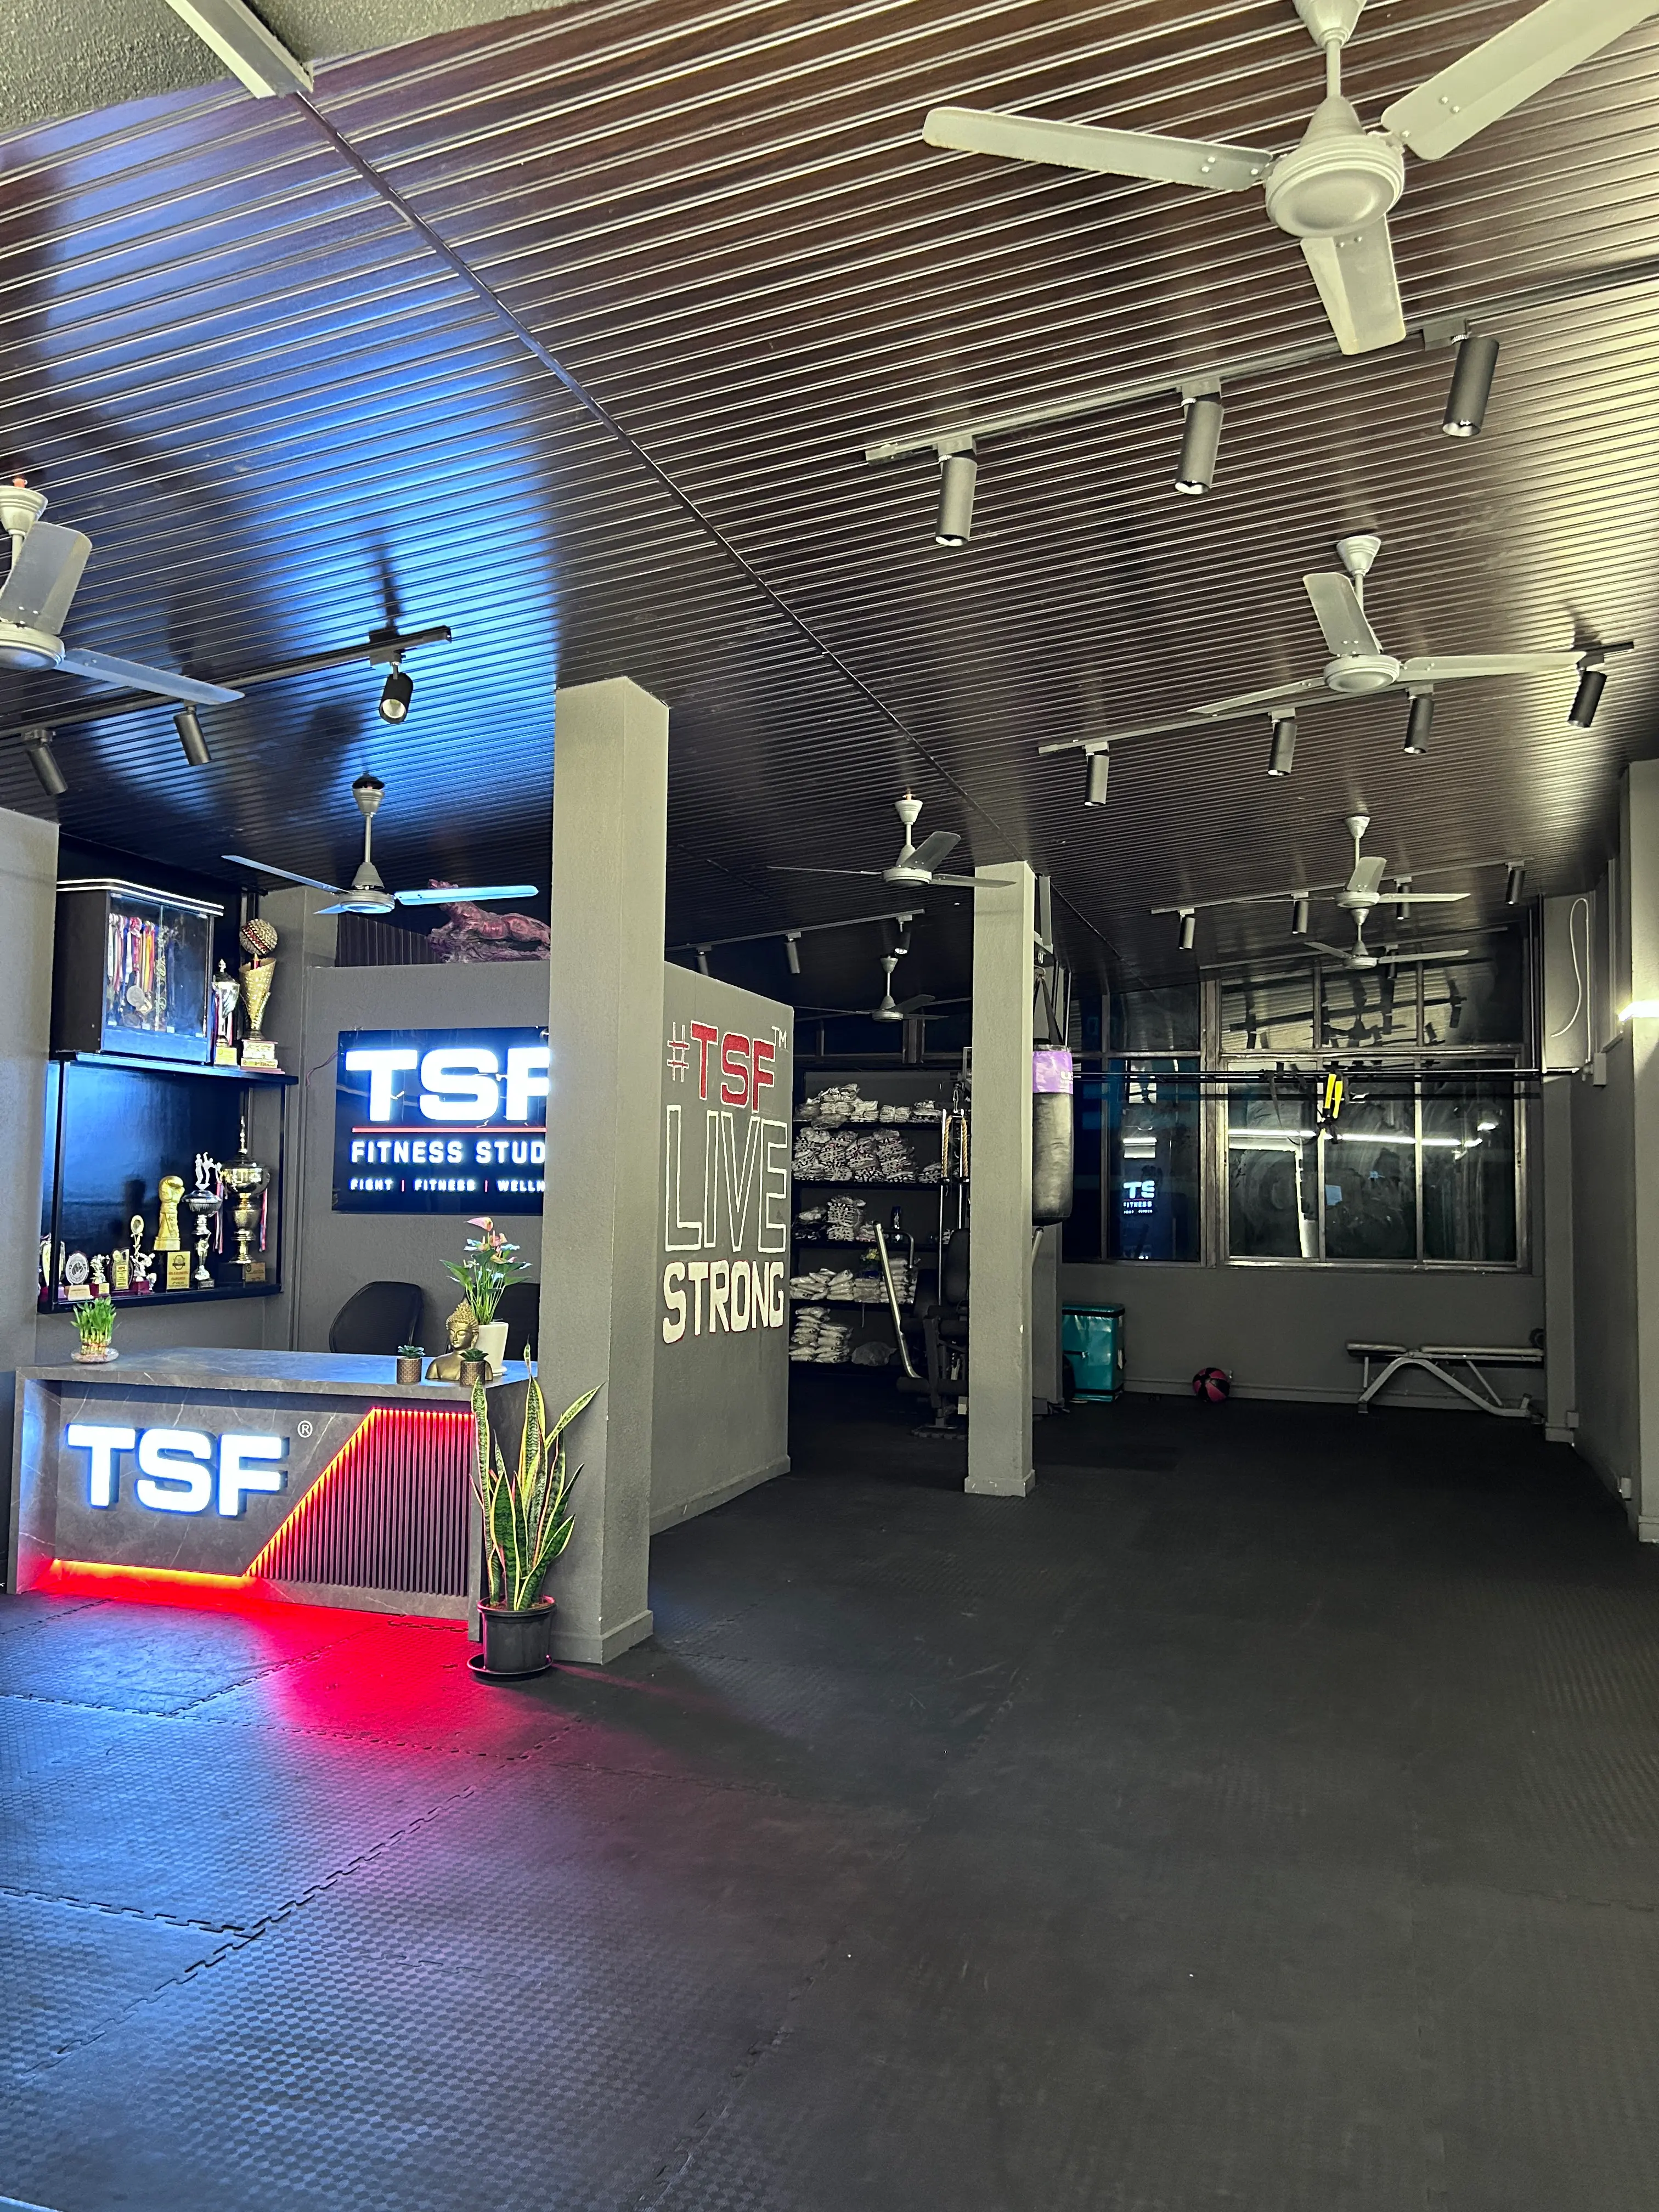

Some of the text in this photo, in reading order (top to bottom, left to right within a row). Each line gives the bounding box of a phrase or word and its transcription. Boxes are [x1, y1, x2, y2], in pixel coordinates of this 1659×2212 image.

[346, 1047, 550, 1121] TSF
[350, 1178, 393, 1190] FIGHT
[414, 1179, 476, 1192] FITNESS
[351, 1141, 545, 1164] FITNESS STUD
[665, 1105, 788, 1252] LIVE
[663, 1260, 784, 1344] STRONG
[66, 1424, 289, 1517] TSF
